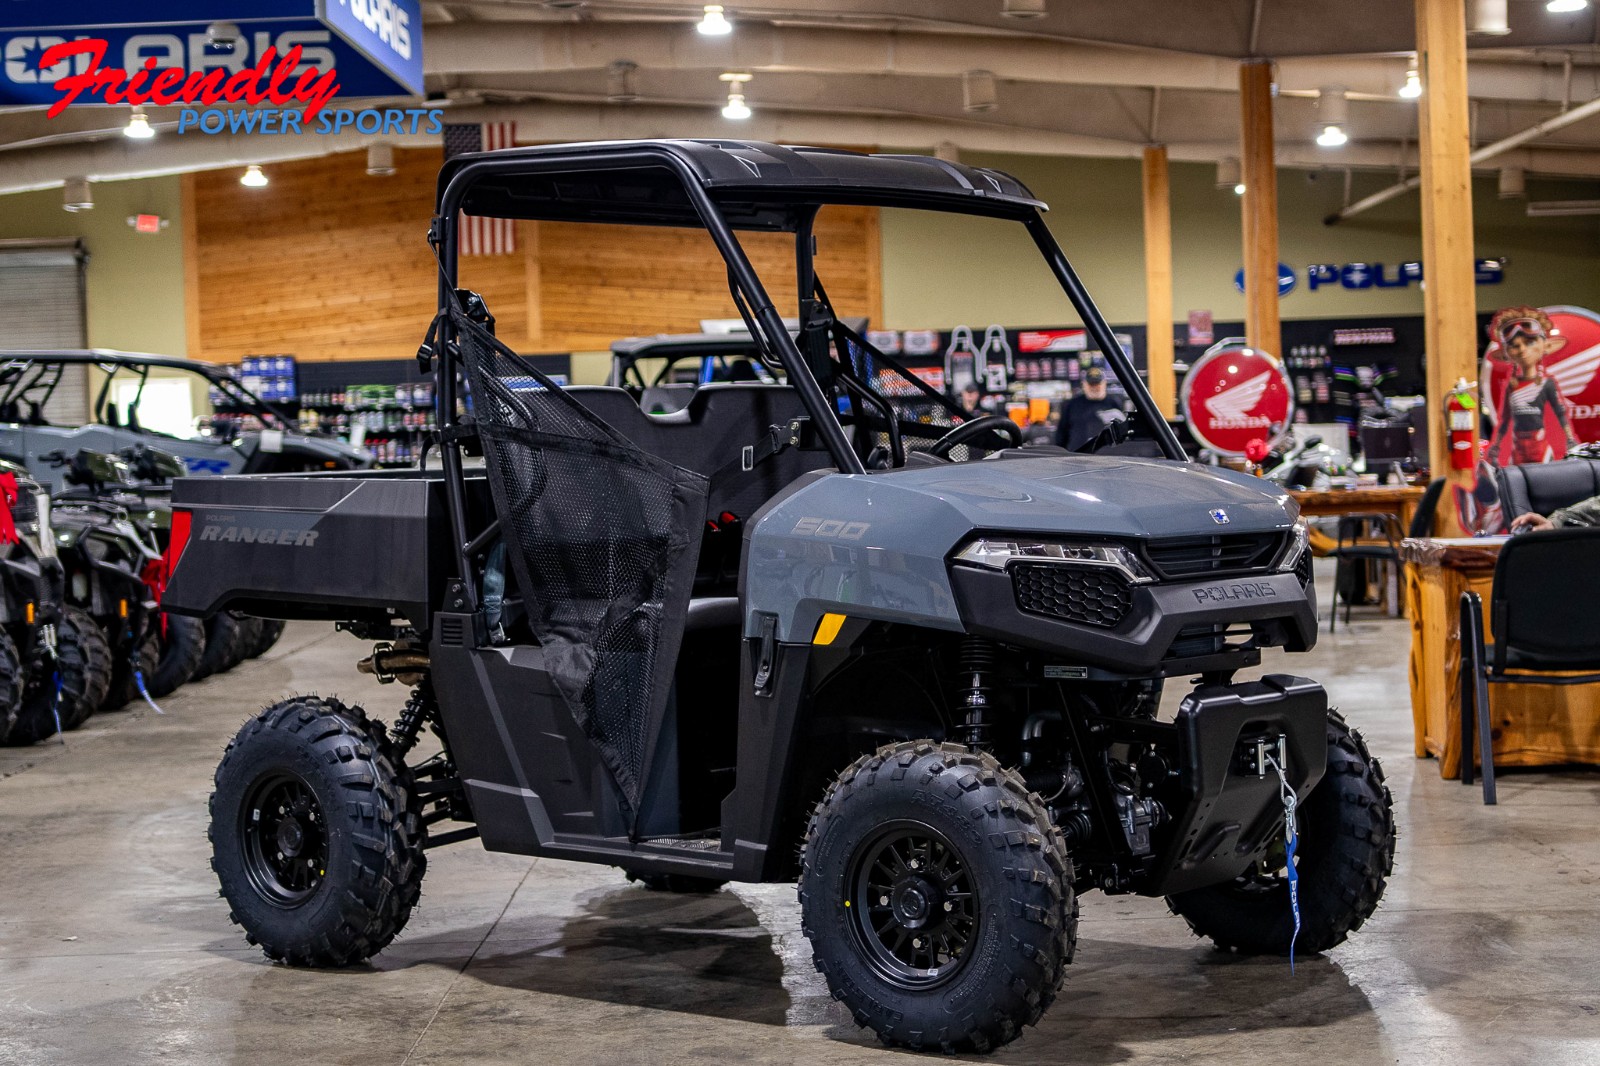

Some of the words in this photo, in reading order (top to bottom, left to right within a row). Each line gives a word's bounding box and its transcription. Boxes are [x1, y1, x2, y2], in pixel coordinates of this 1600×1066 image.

[340, 0, 411, 60] OLARIS
[1308, 262, 1503, 291] POLAS
[1209, 415, 1272, 429] HONDA
[200, 525, 319, 547] RANGER
[790, 517, 871, 540] 500
[1192, 582, 1276, 604] POLARIS
